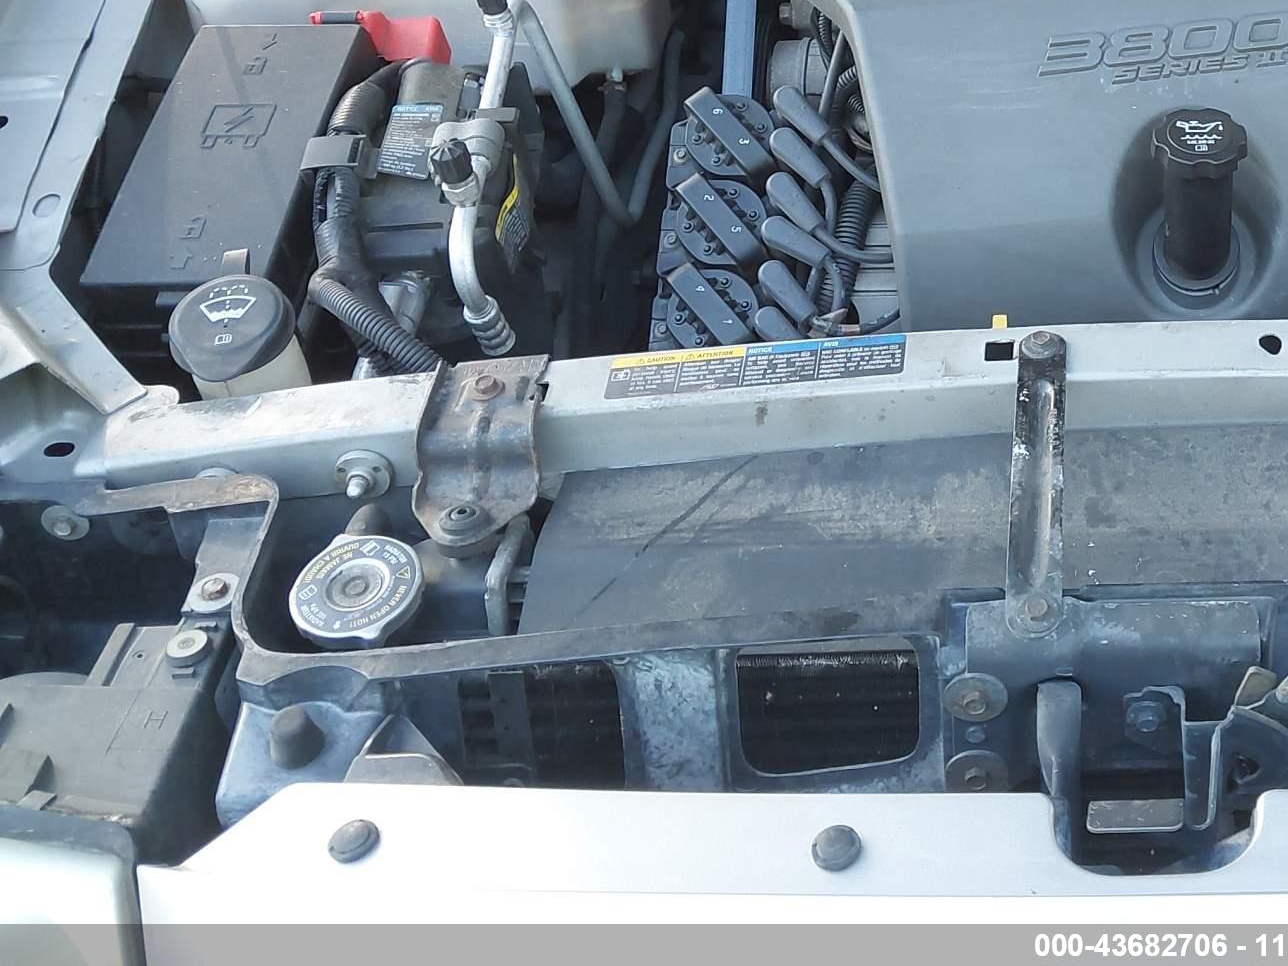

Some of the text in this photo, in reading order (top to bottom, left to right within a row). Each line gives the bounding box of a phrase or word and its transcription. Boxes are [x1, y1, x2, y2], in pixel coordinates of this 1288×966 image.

[1112, 53, 1249, 85] SERIES
[731, 225, 742, 233] 5
[748, 346, 773, 354] NOTICE
[697, 350, 734, 359] ATTENTION
[647, 355, 676, 363] CAUTION
[369, 605, 391, 622] OPEN
